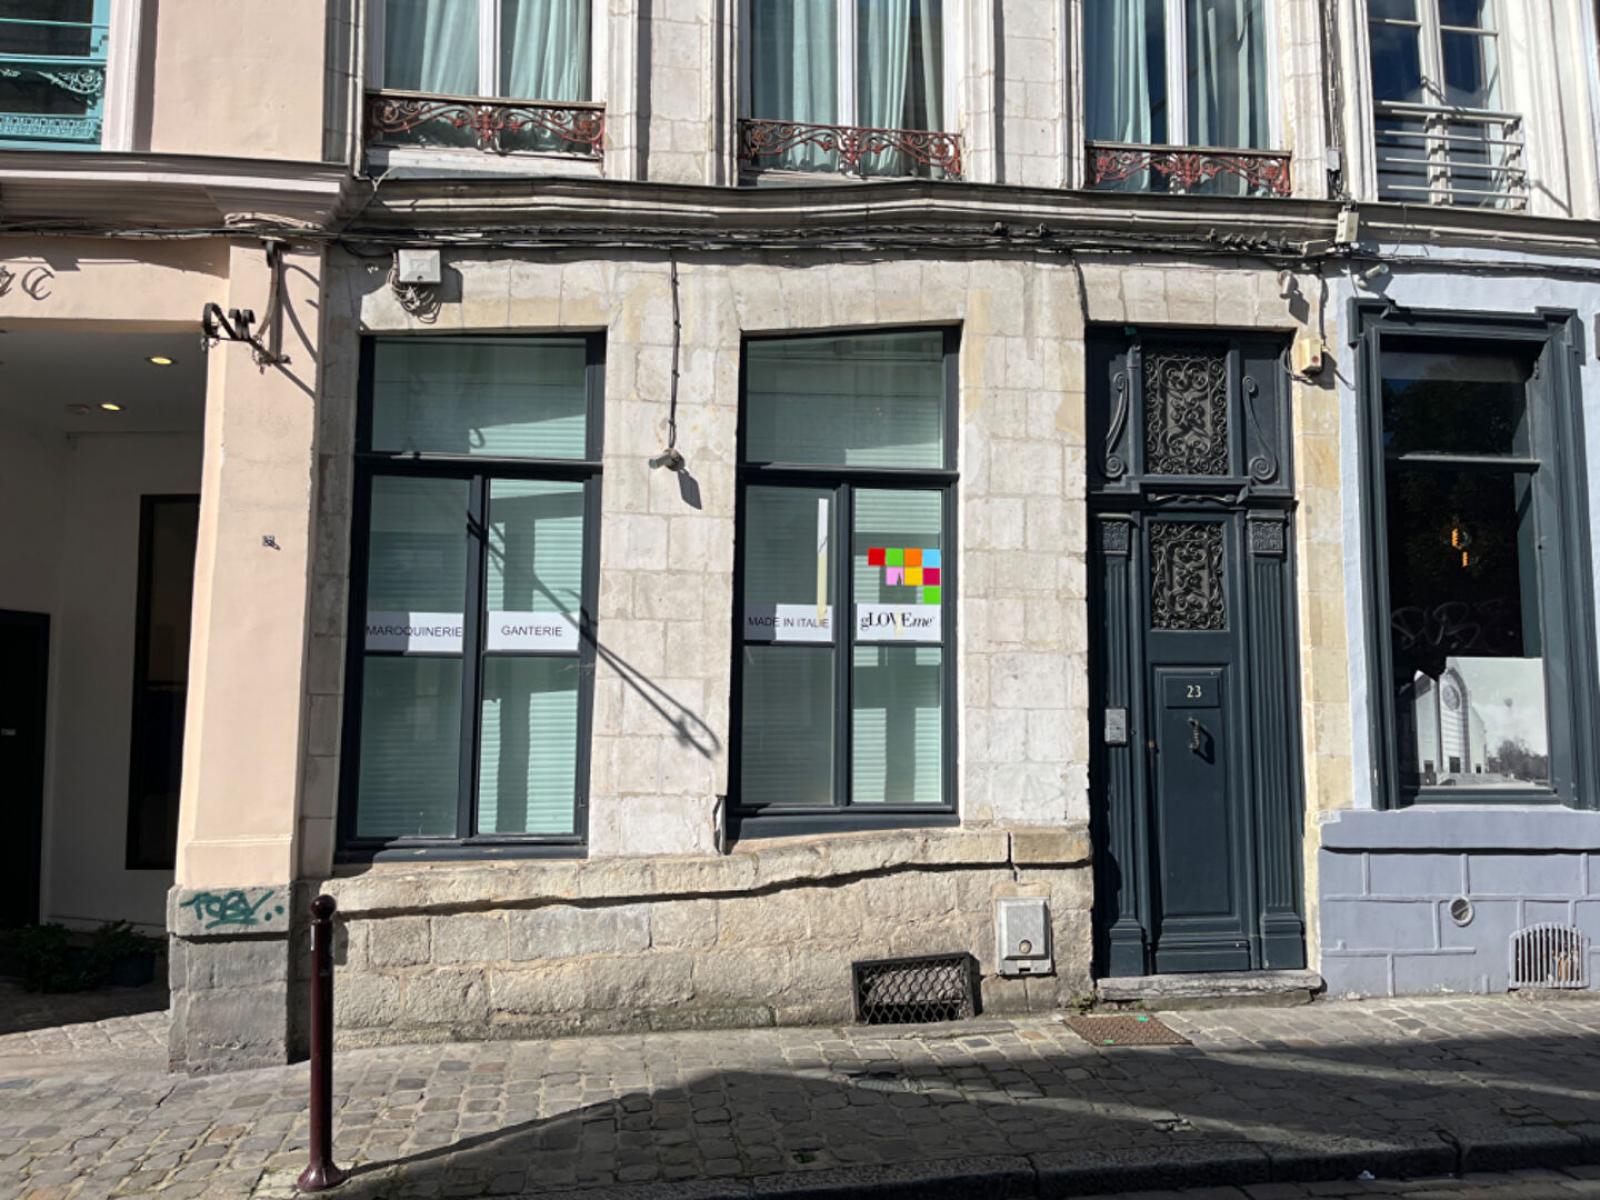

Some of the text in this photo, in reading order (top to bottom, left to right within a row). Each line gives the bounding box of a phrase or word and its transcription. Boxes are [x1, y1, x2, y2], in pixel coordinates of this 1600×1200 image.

[748, 616, 780, 628] MADE
[783, 617, 795, 628] IN
[365, 625, 463, 637] MAROQUINERIE
[501, 625, 562, 637] GANTERIE
[1186, 684, 1202, 698] 23
